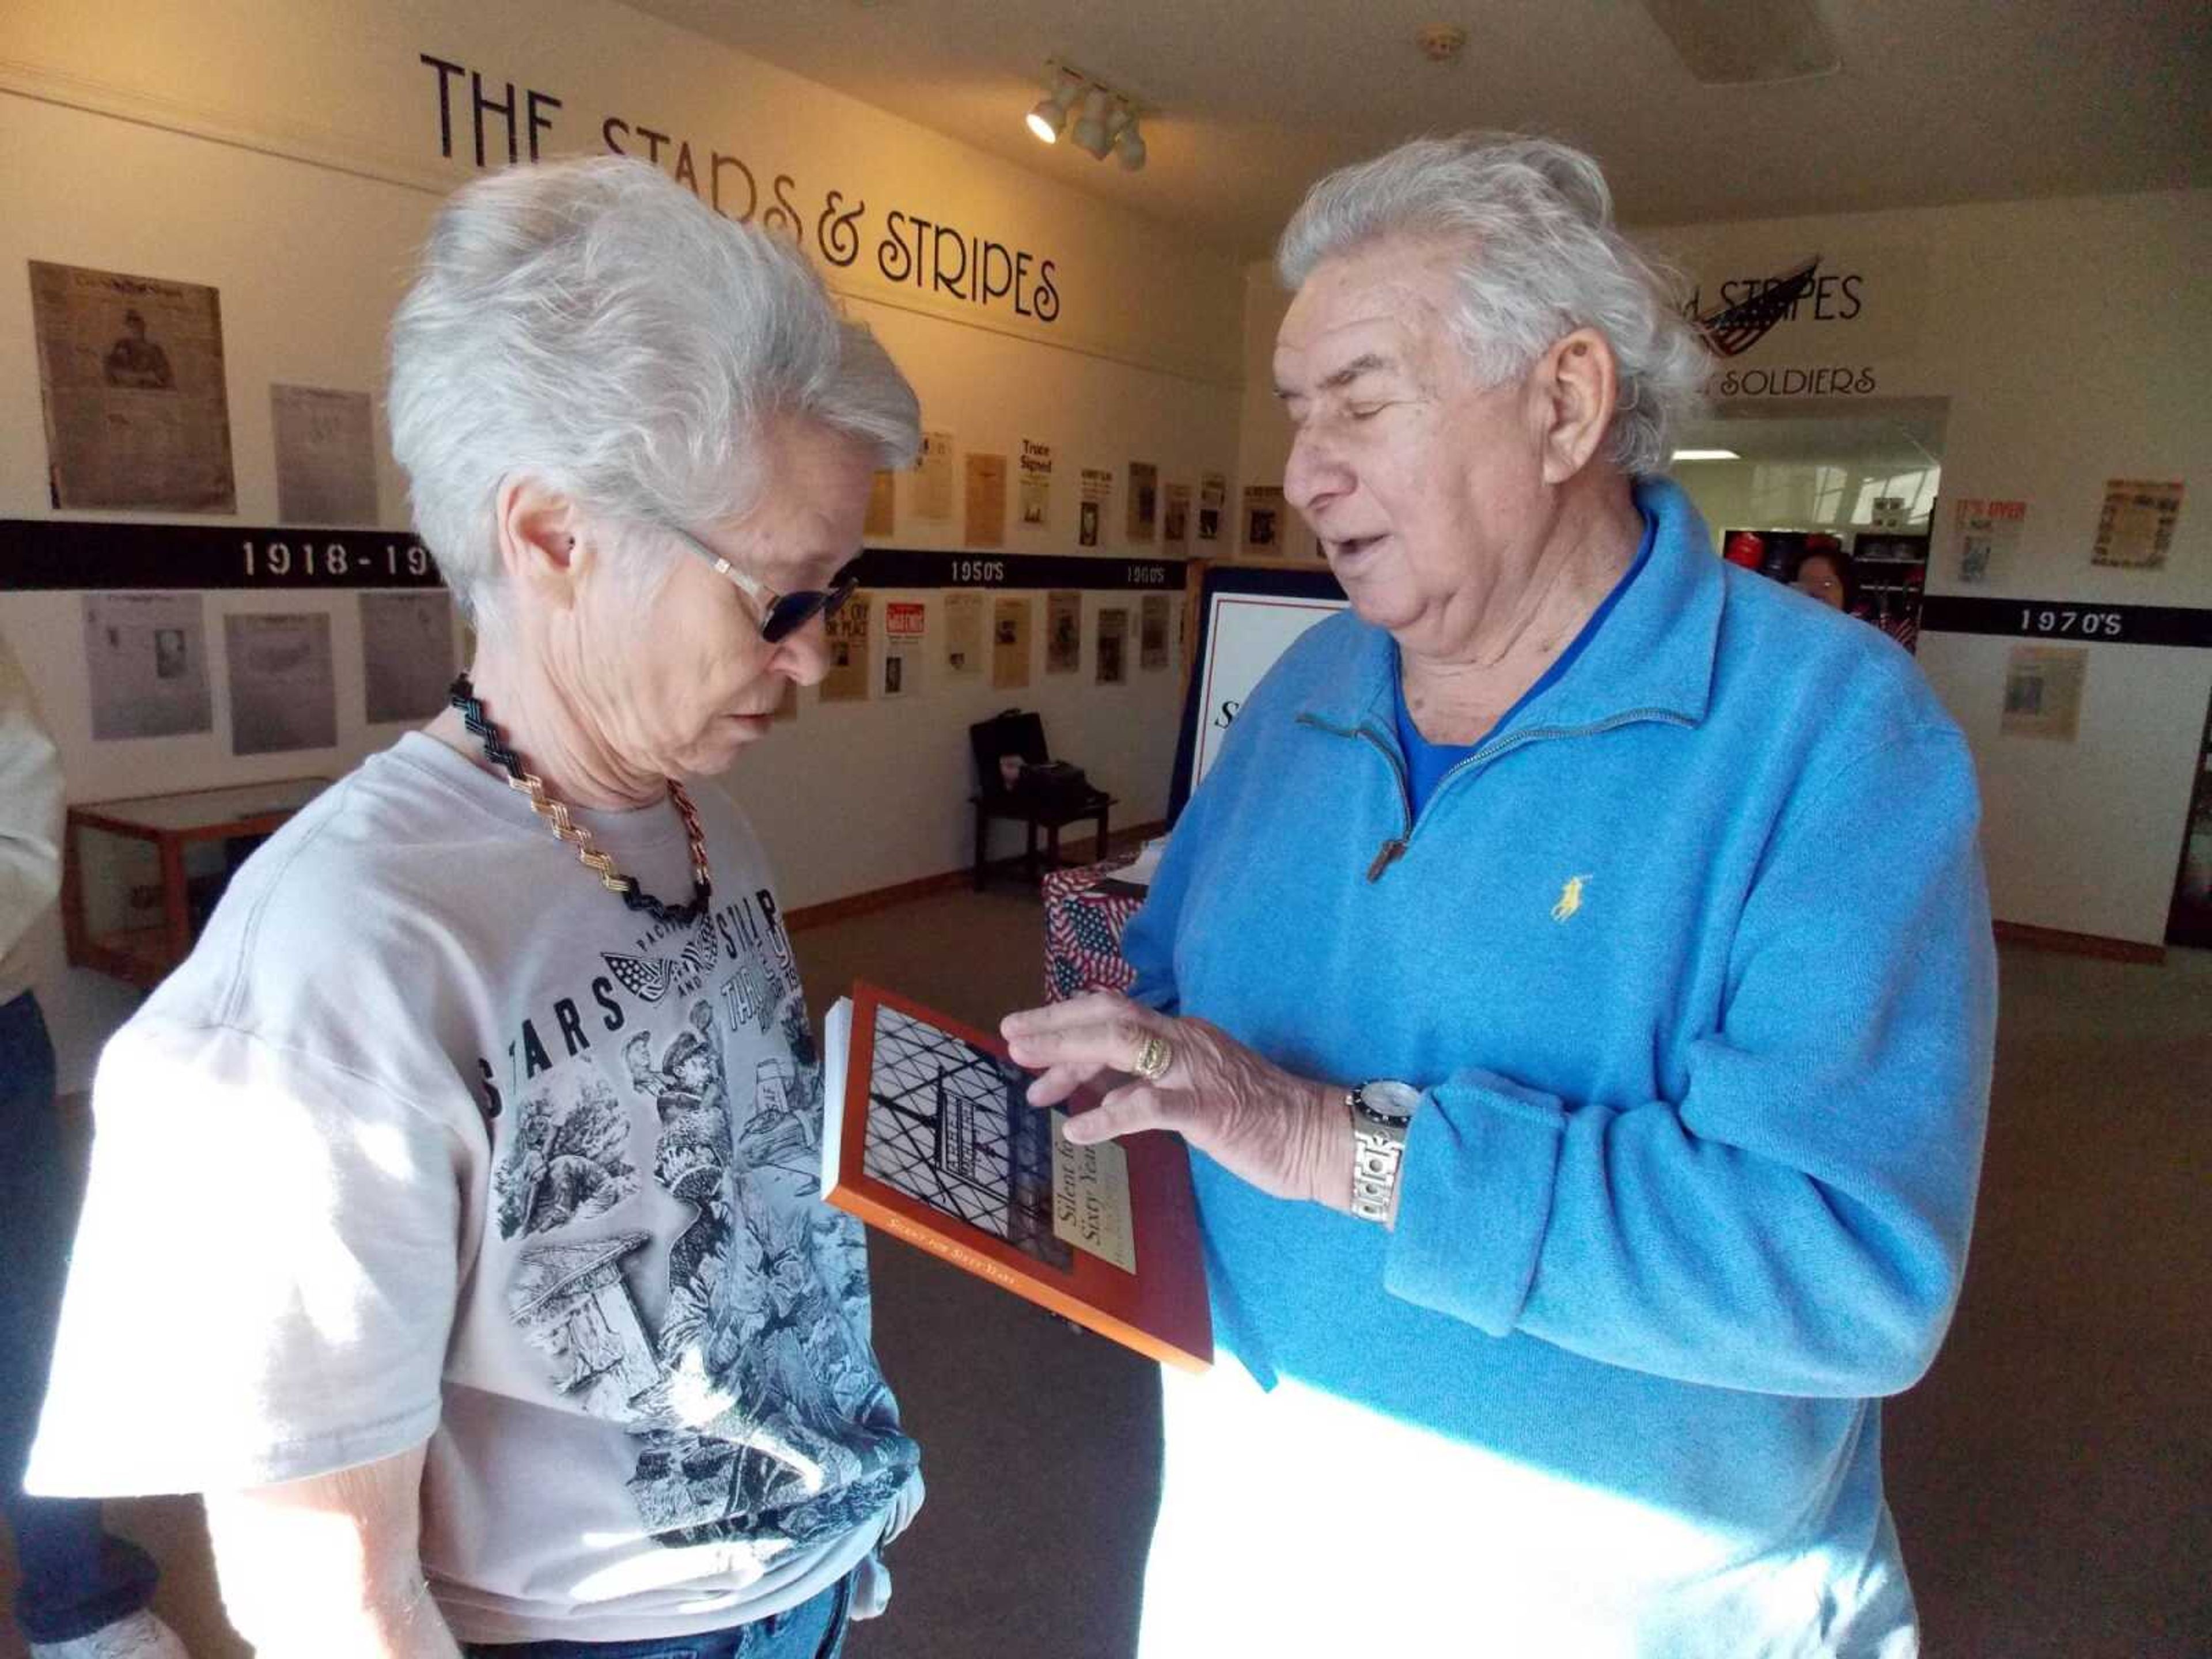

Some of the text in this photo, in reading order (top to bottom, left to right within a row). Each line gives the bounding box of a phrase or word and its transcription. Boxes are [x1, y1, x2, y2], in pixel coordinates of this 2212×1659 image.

[818, 191, 865, 267] &
[878, 210, 1060, 322] STRIPES
[1721, 368, 1876, 395] SOLDIERS
[952, 562, 1005, 582] 1950'S
[2022, 609, 2122, 635] 1970'S
[1055, 1140, 1077, 1228] Silent fo
[1078, 1143, 1105, 1246] Sixty Year
